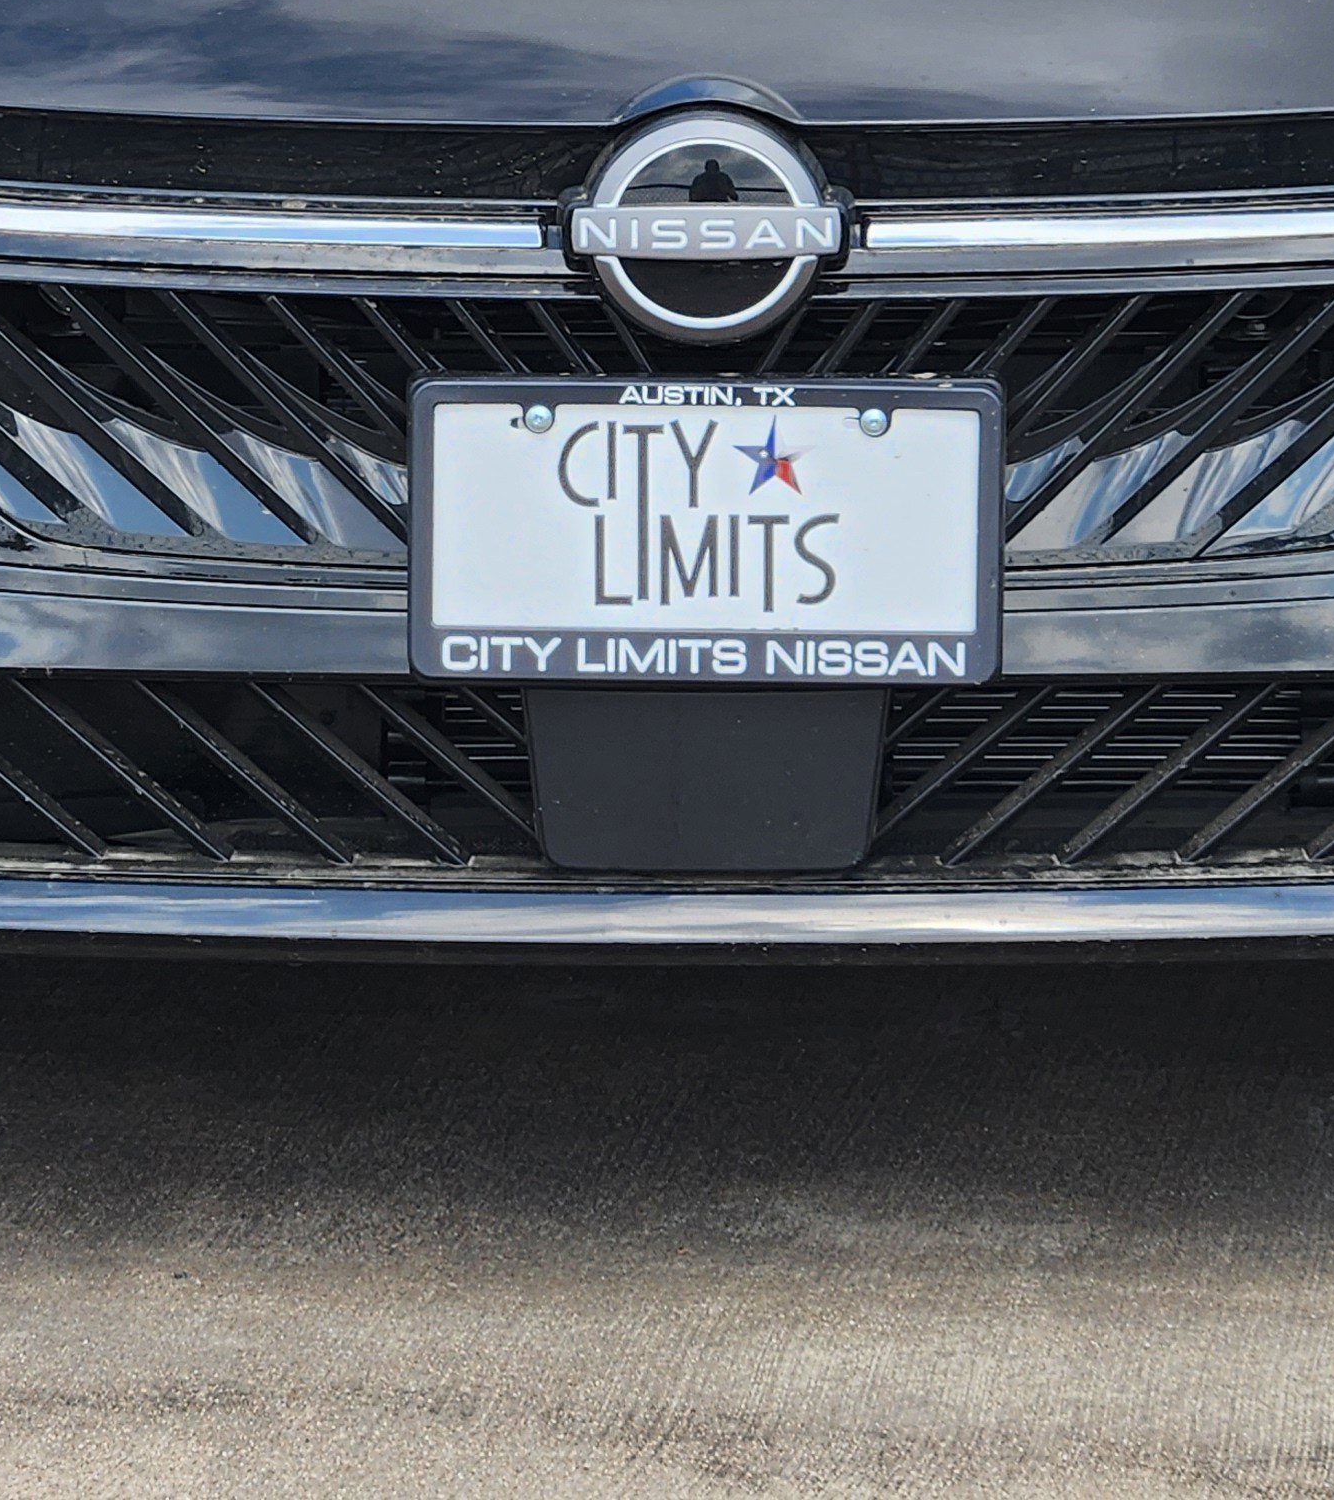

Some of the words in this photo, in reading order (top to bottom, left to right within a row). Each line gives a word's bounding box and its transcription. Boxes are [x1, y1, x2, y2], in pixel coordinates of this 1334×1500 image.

[578, 216, 834, 250] NISSAN
[619, 386, 742, 407] AUSTIN,
[752, 386, 796, 407] TX
[594, 513, 840, 612] LIMITS
[441, 635, 562, 673] CITY
[576, 637, 747, 675] LIMITS
[766, 640, 967, 676] NISSAN
